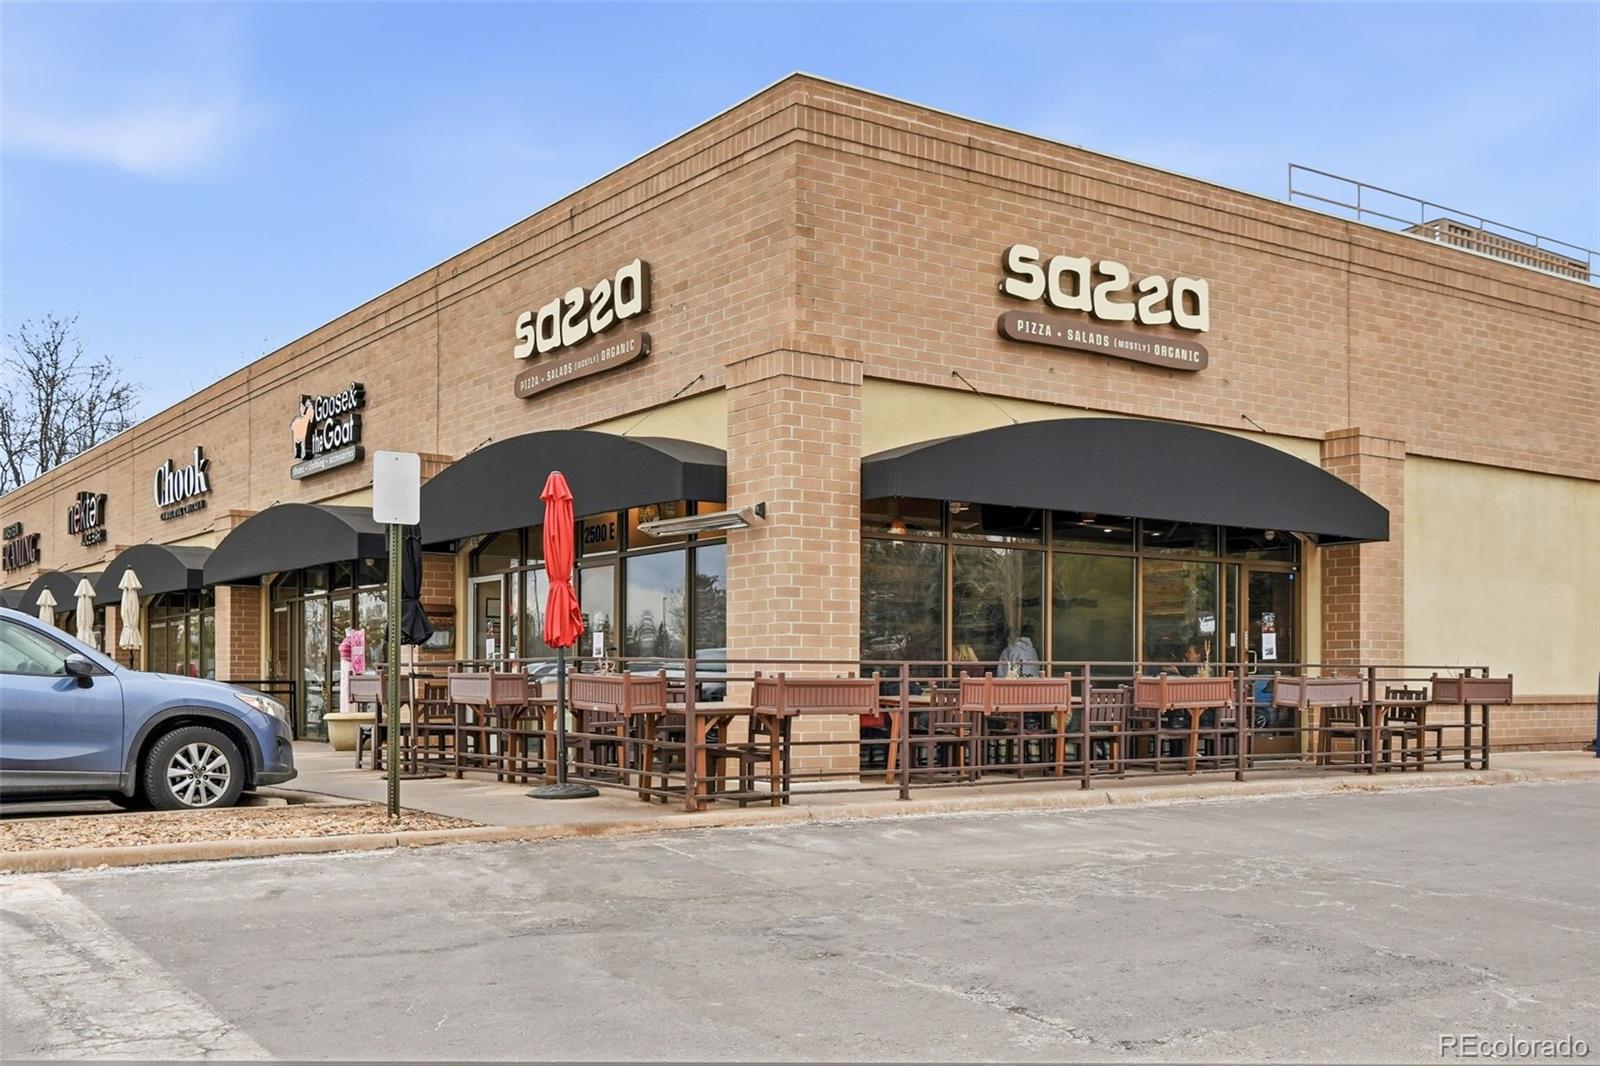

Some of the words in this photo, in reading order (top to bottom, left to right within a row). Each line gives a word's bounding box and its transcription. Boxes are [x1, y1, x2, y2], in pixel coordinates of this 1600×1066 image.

[514, 258, 641, 359] sazza
[1005, 244, 1210, 332] sazza
[520, 375, 539, 393] PIZZA
[547, 363, 573, 382] SALADS
[601, 339, 635, 361] ORGANIC
[1017, 319, 1052, 337] PIZZA
[1067, 328, 1110, 347] SALADS
[1154, 344, 1200, 363] ORGANIC
[323, 413, 354, 449] Goat
[155, 446, 208, 507] Chook
[585, 524, 607, 544] 2500
[609, 522, 616, 540] E
